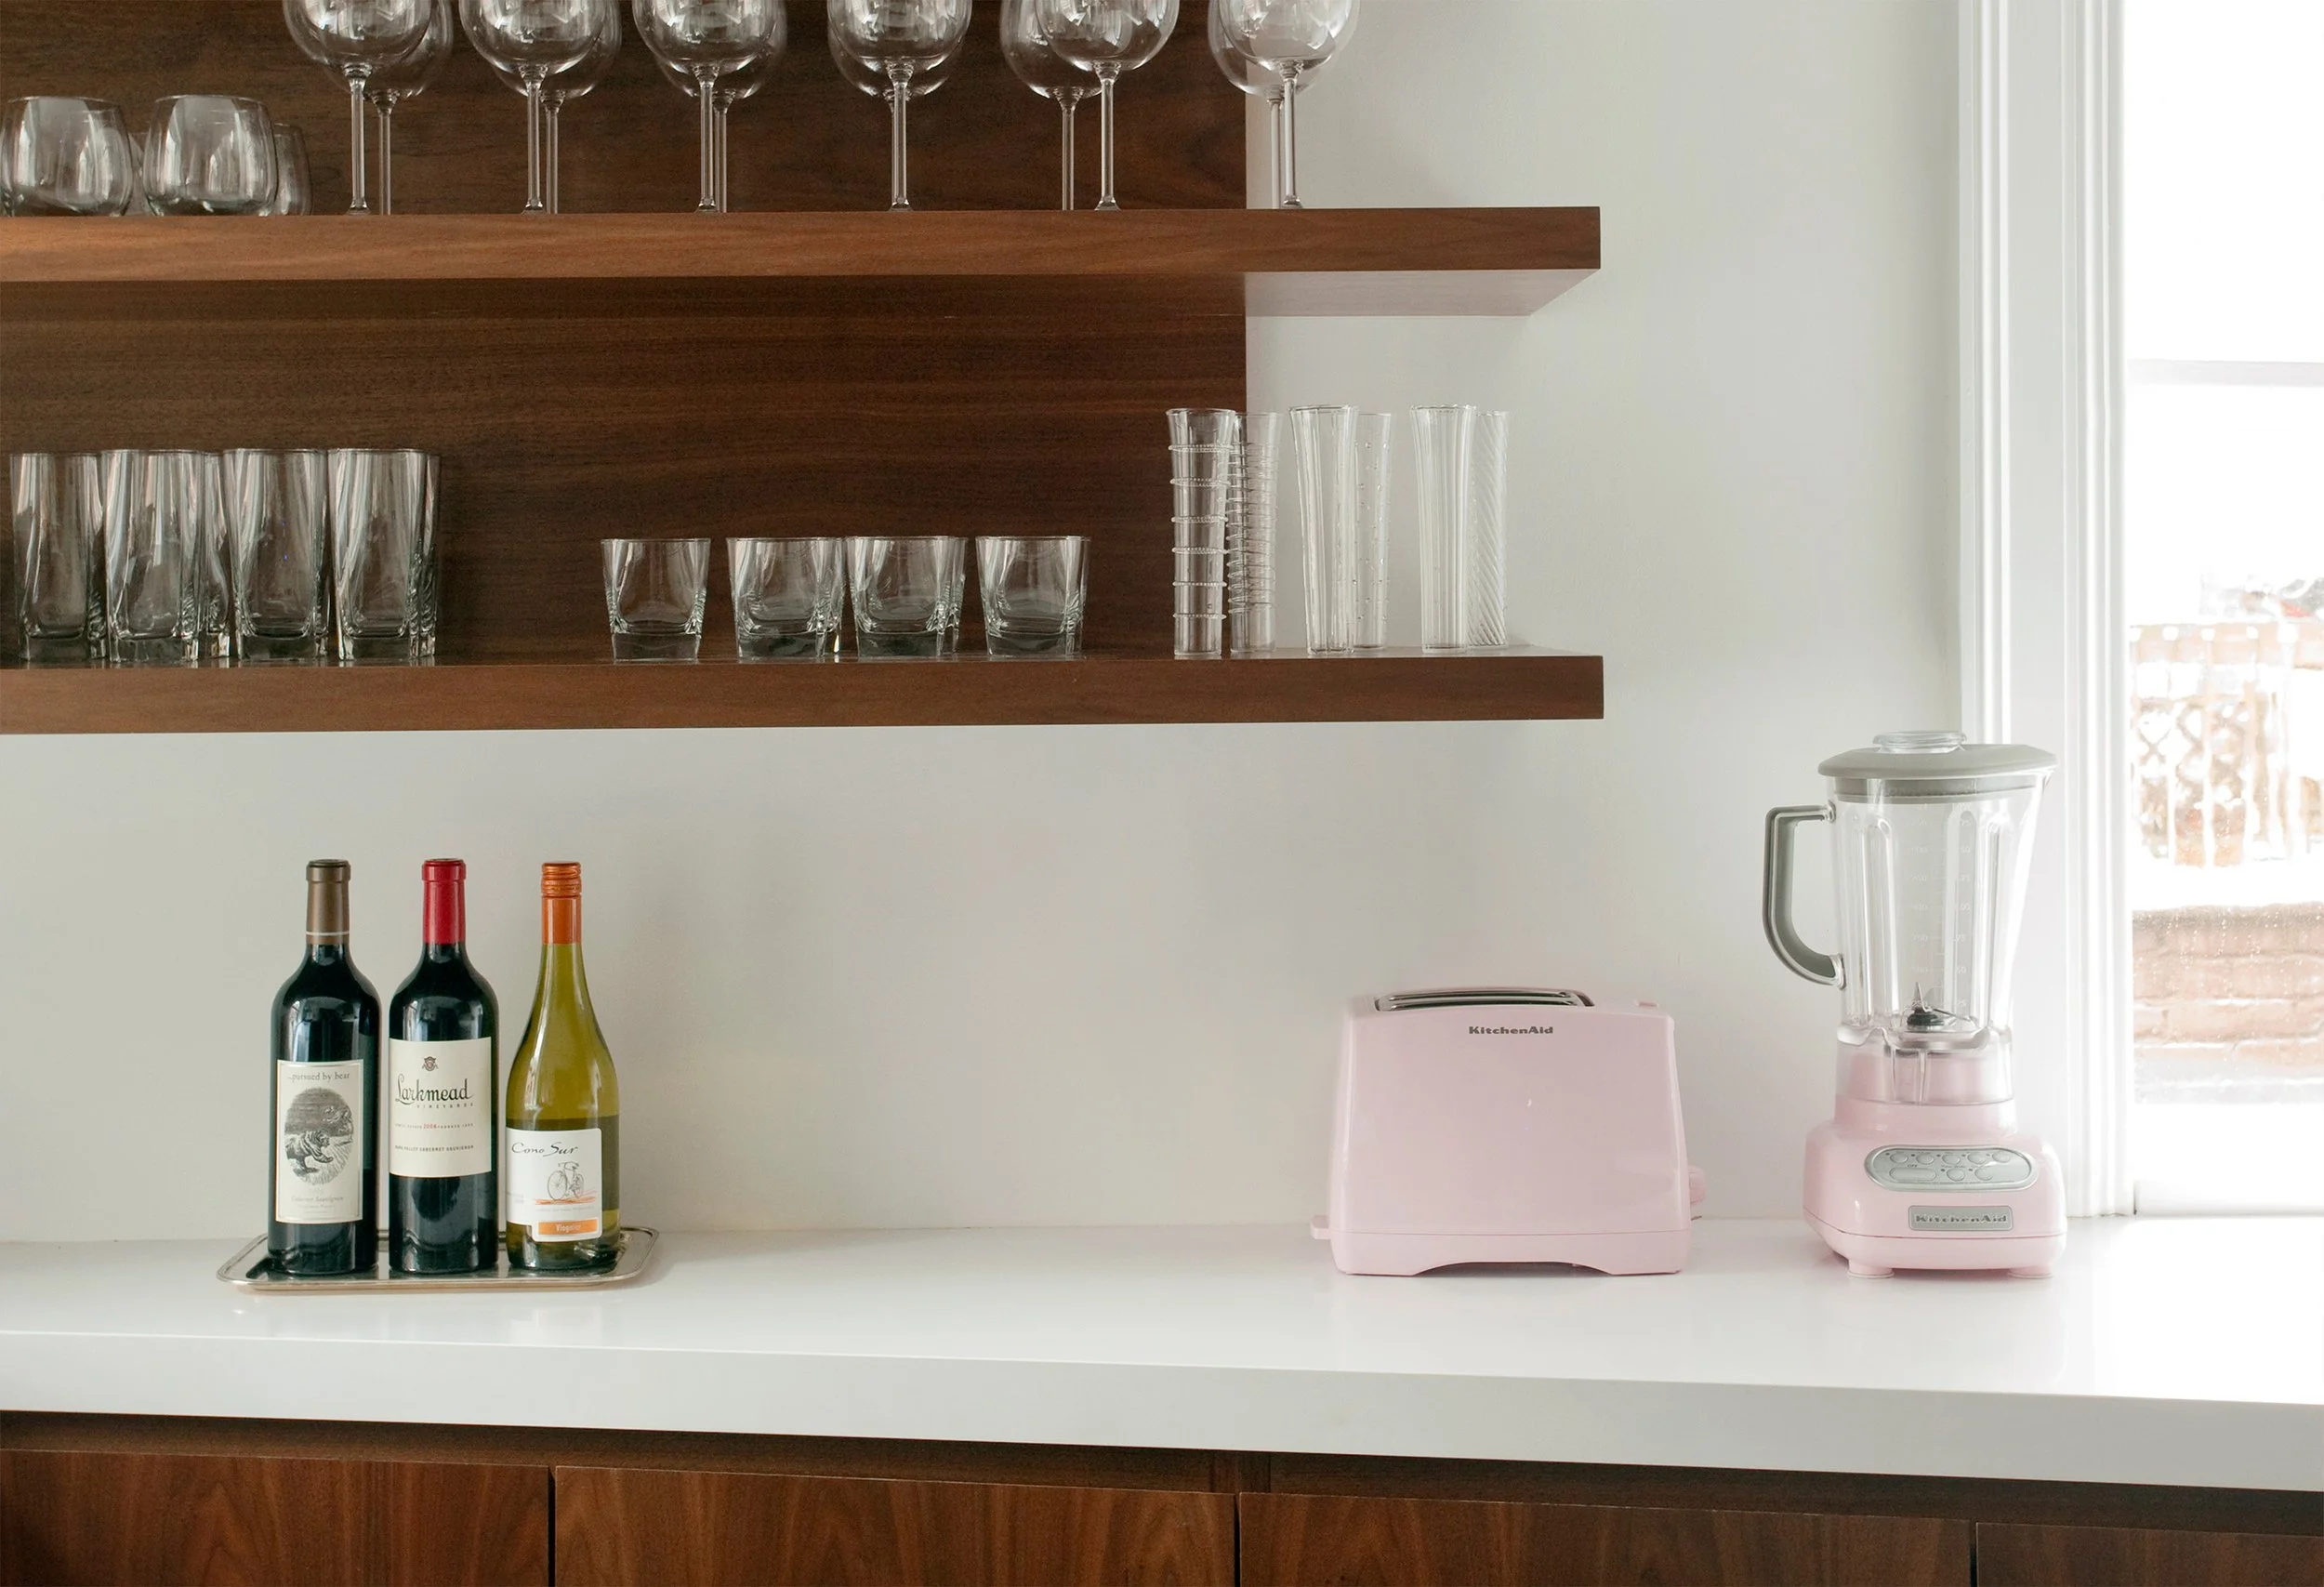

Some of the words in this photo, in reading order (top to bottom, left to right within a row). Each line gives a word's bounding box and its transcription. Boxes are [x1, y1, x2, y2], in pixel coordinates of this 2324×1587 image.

[1468, 1025, 1553, 1035] KitchenAid
[323, 1071, 333, 1083] by
[335, 1071, 350, 1080] bear
[395, 1073, 475, 1105] Larkmead
[511, 1142, 545, 1155] Cono
[543, 1141, 578, 1157] Sur
[1915, 1214, 2007, 1223] KitchenAid
